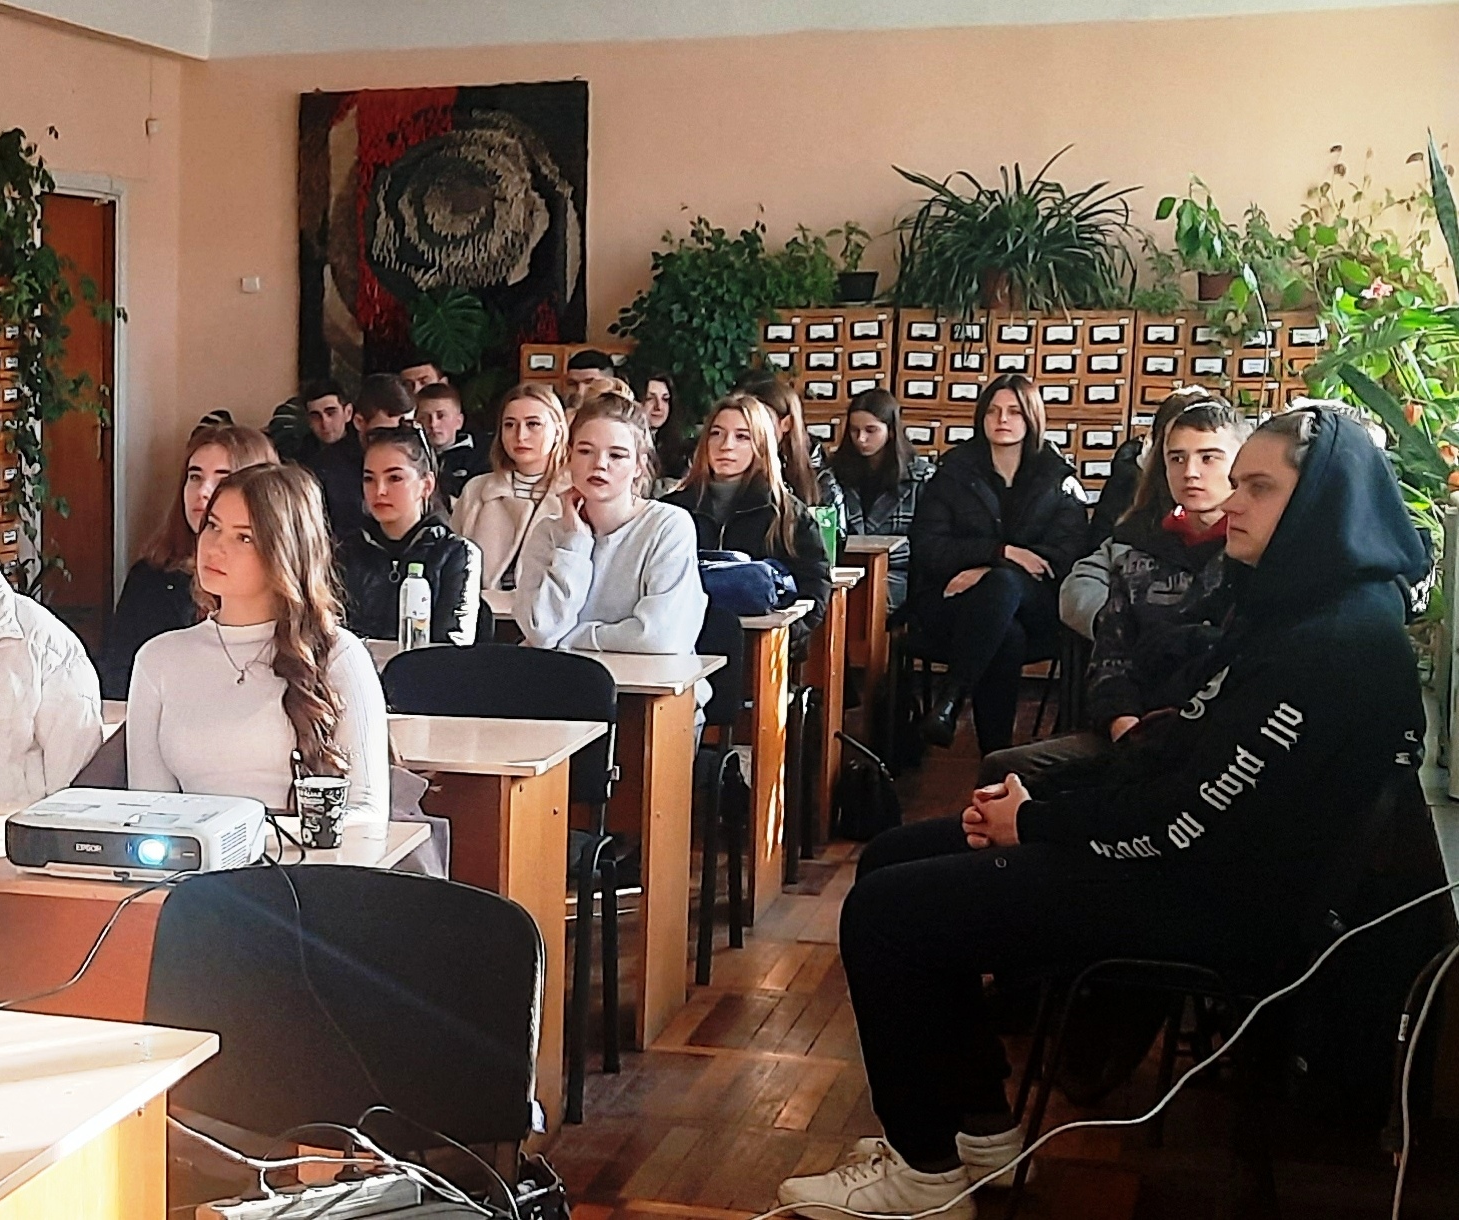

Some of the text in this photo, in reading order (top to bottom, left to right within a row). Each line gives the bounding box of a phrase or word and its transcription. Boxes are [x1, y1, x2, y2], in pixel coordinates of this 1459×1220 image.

[1260, 702, 1304, 751] all
[1199, 744, 1266, 812] play
[1167, 811, 1206, 849] no
